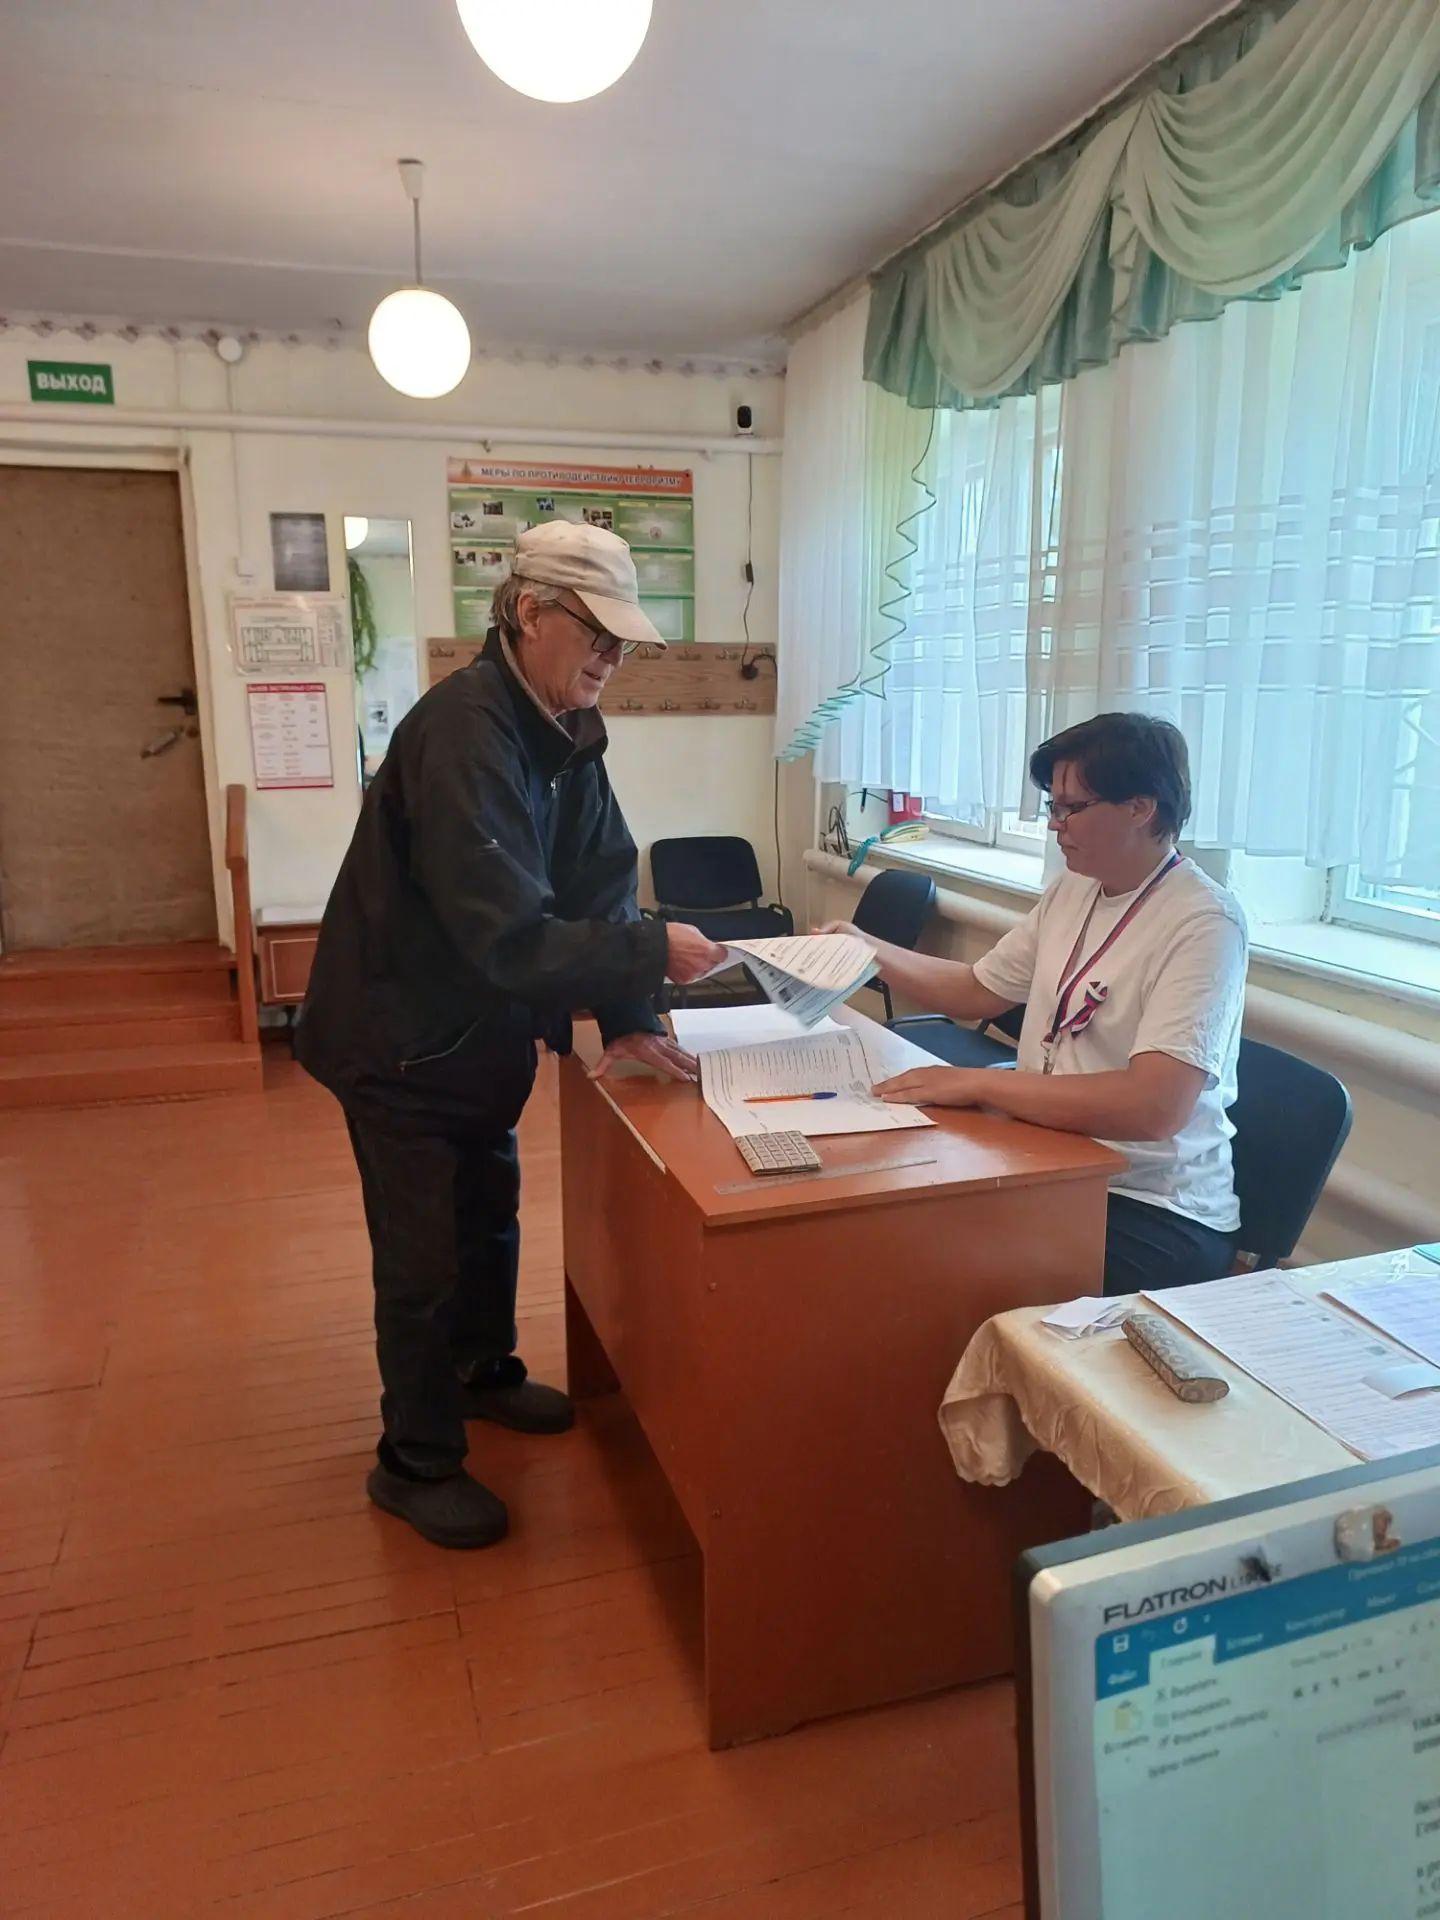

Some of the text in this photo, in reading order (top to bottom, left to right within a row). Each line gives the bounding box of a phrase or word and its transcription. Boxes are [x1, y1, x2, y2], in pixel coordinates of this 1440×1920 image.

[36, 372, 107, 396] ВЫХОД
[481, 467, 510, 478] МЕРЫ
[512, 469, 526, 479] ПО
[1104, 1575, 1227, 1625] FLATRON
